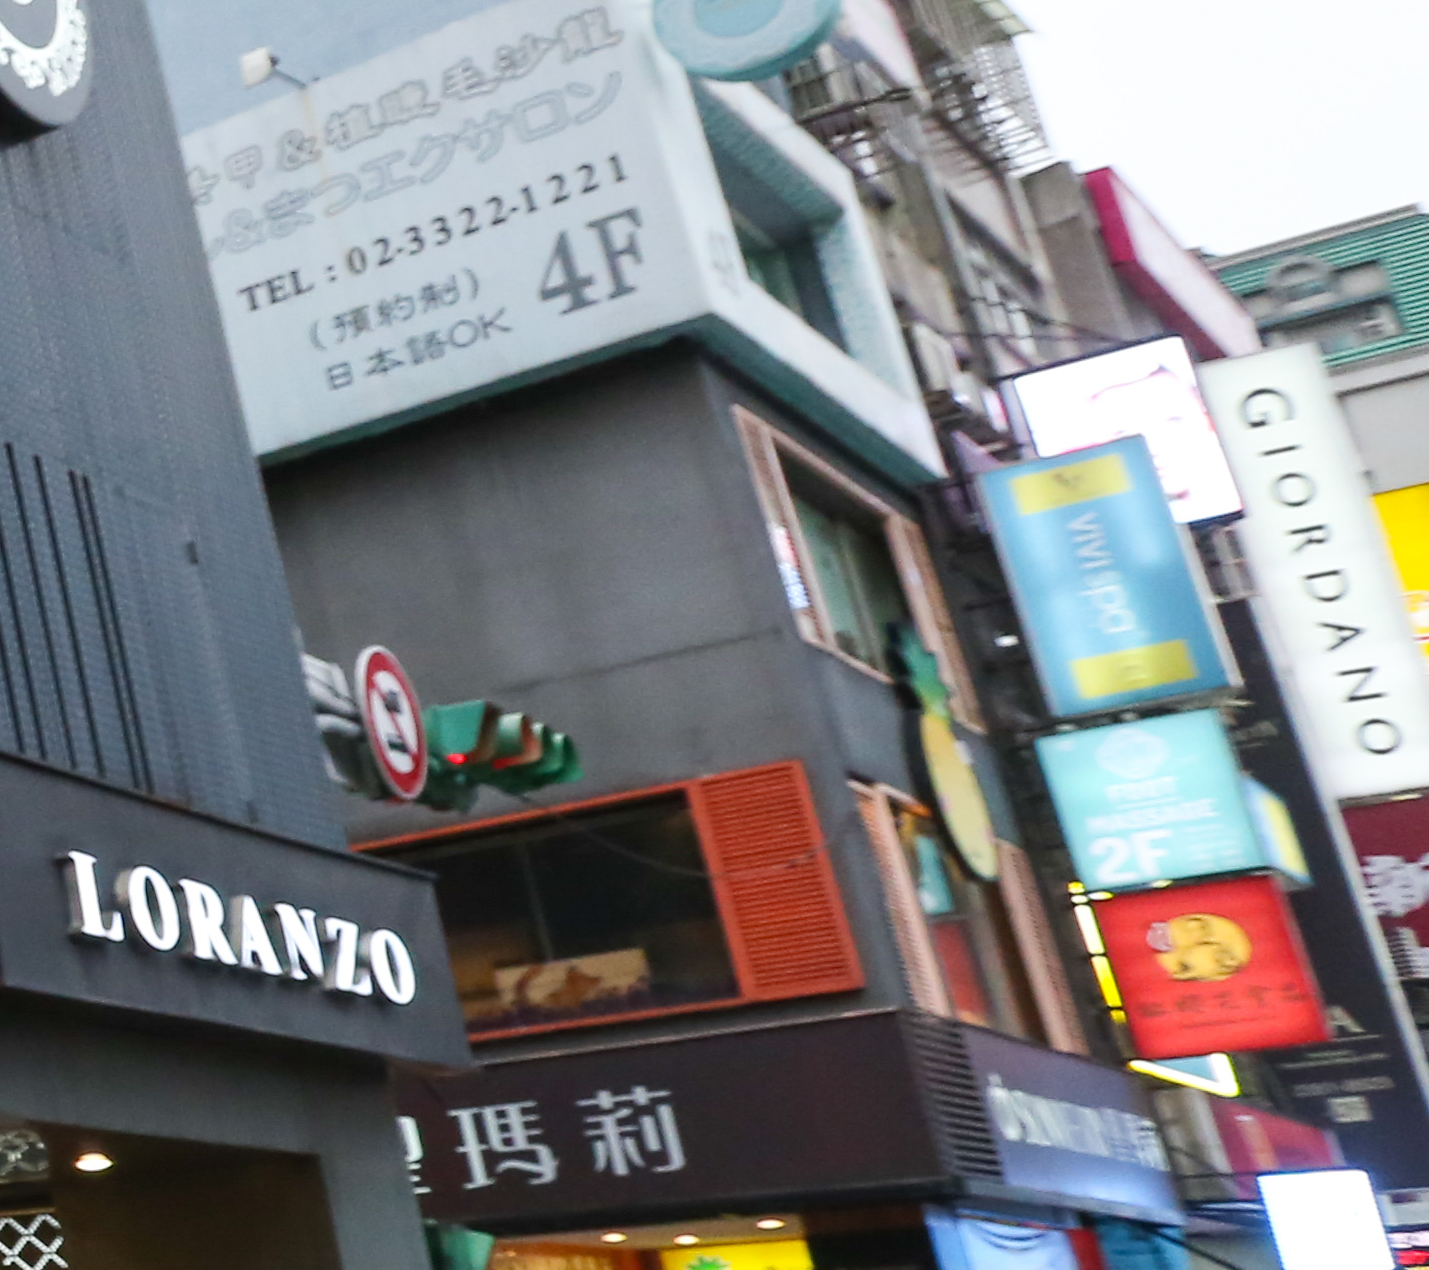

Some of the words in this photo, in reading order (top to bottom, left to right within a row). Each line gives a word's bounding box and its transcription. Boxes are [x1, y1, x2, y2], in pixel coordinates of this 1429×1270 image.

[346, 152, 630, 277] 02-3322-1221
[537, 206, 646, 316] 4F
[1241, 387, 1404, 757] GIORDANO
[1088, 828, 1173, 885] 2F
[60, 849, 416, 1006] LORANZO
